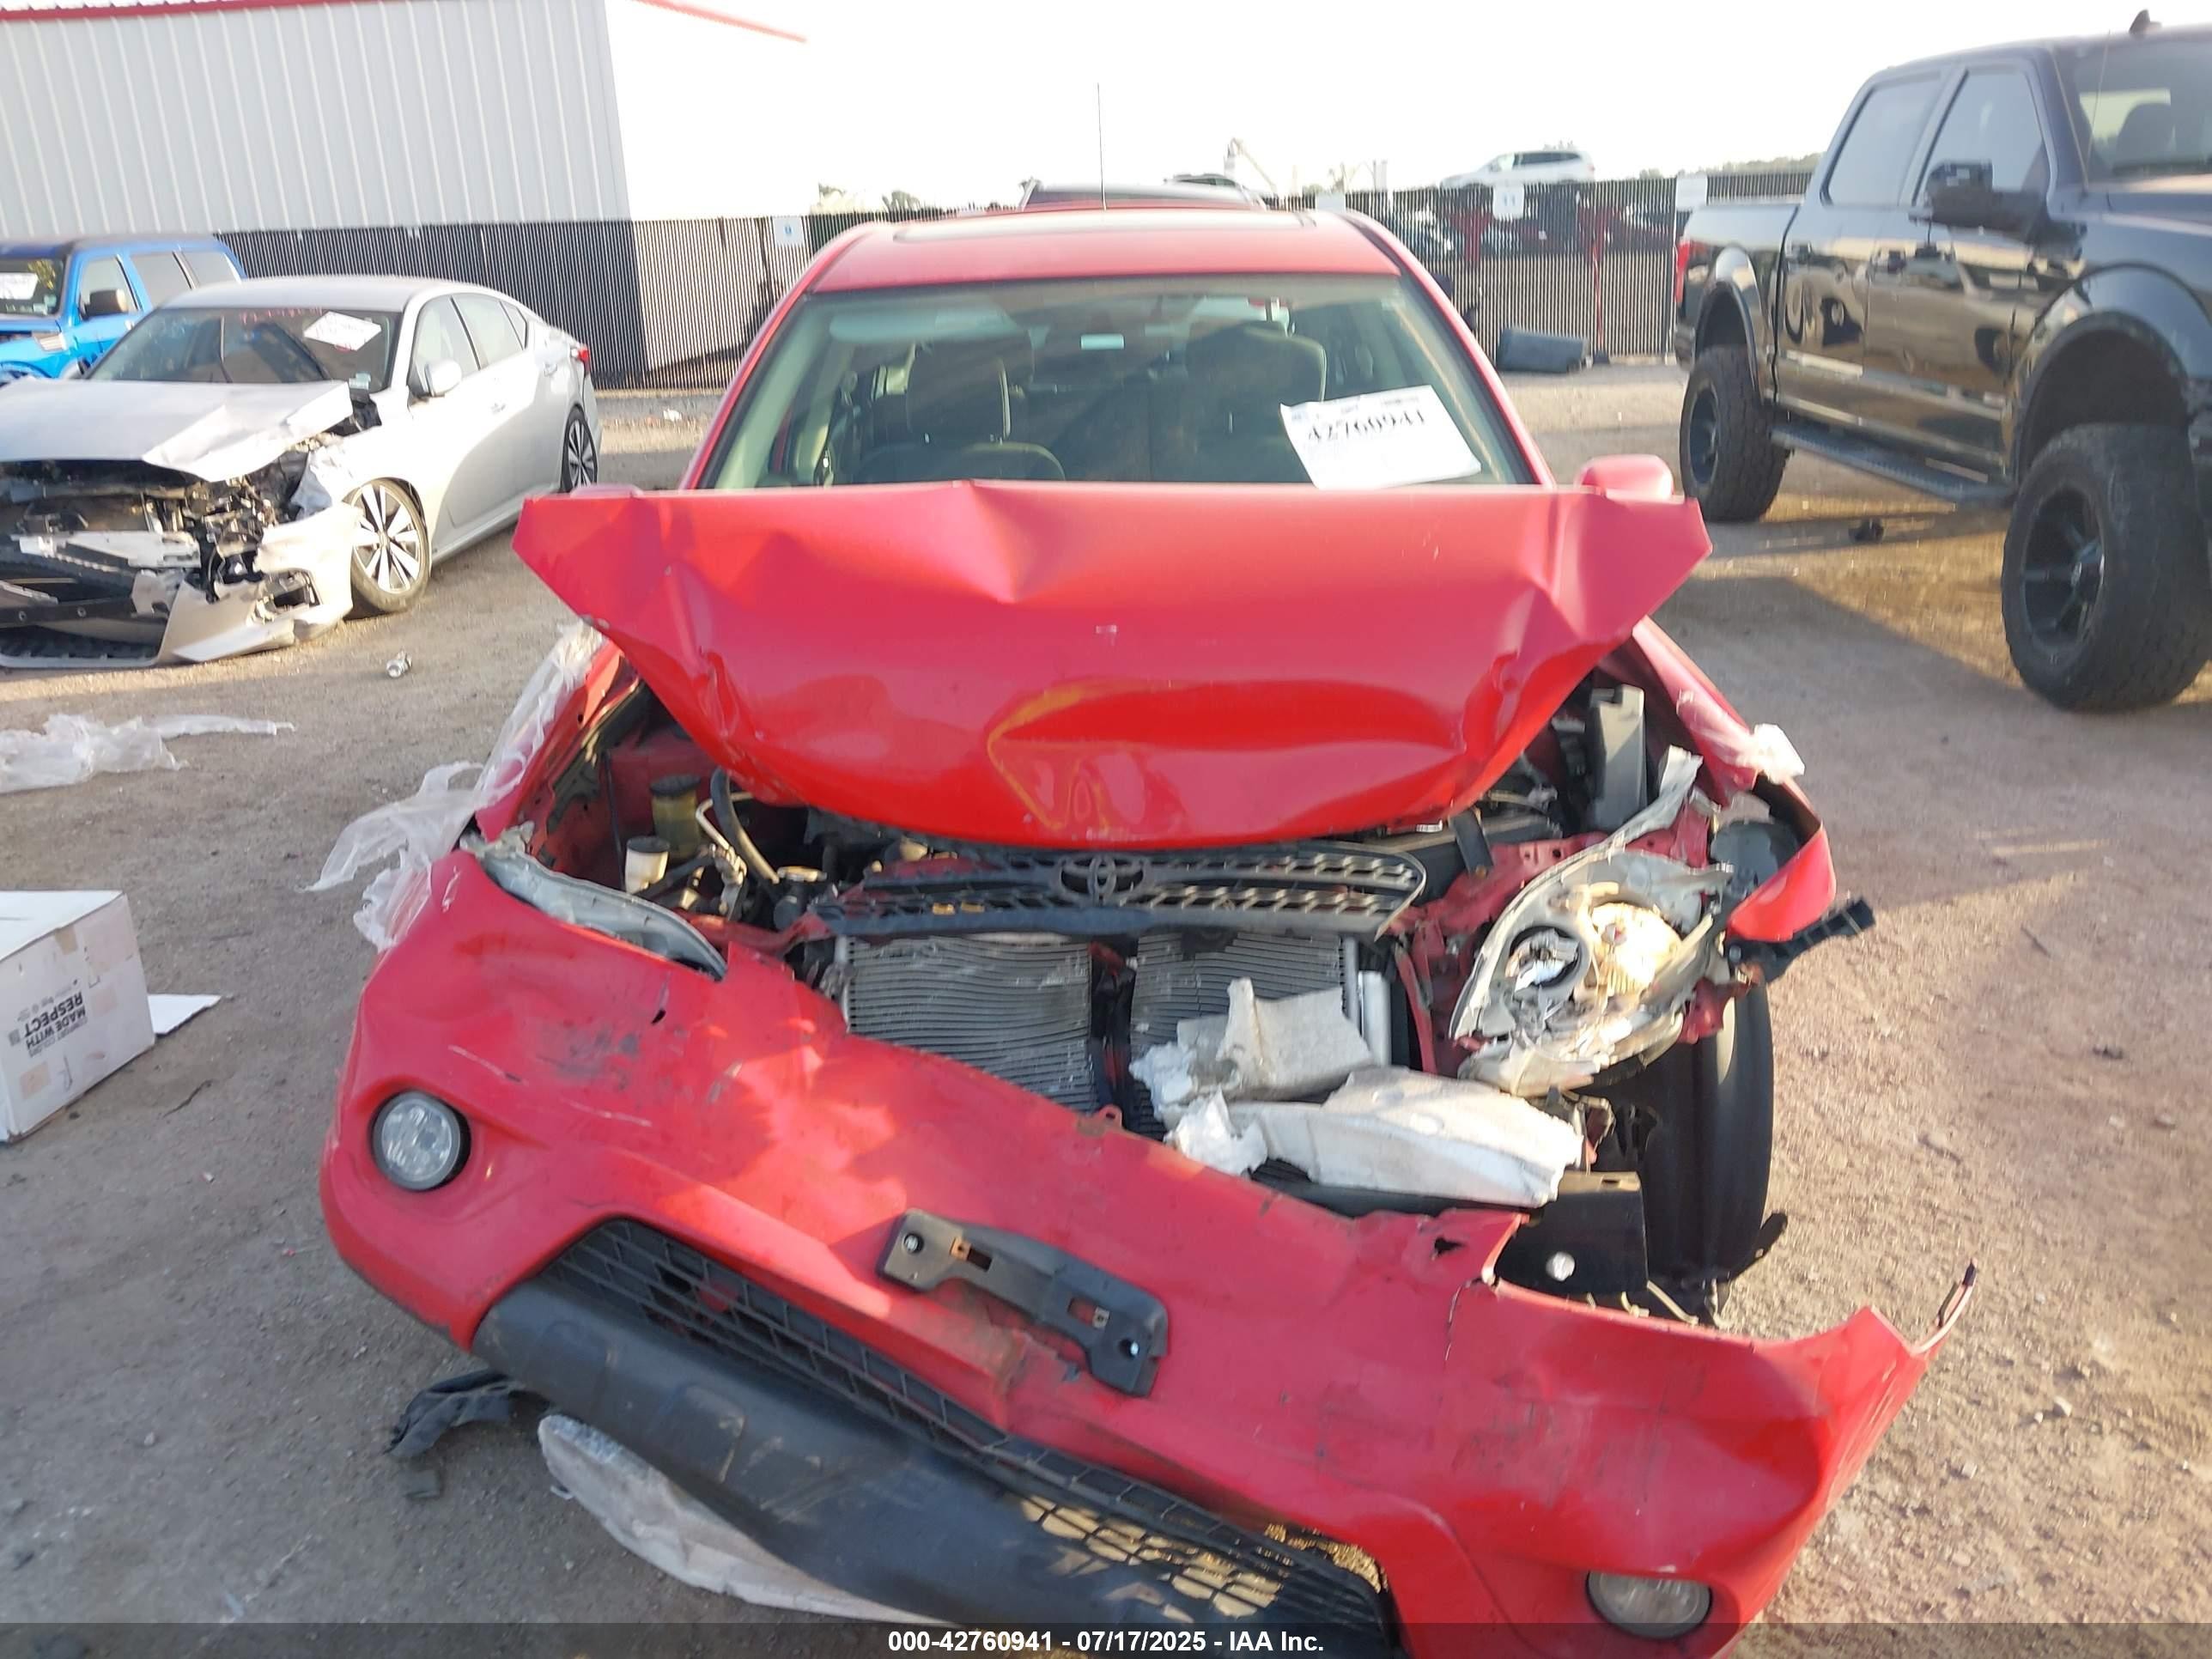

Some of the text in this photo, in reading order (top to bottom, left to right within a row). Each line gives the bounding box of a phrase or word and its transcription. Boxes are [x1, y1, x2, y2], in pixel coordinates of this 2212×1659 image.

[24, 991, 83, 1038] RESPECT
[55, 1005, 86, 1031] MADE
[26, 1026, 54, 1049] WITH
